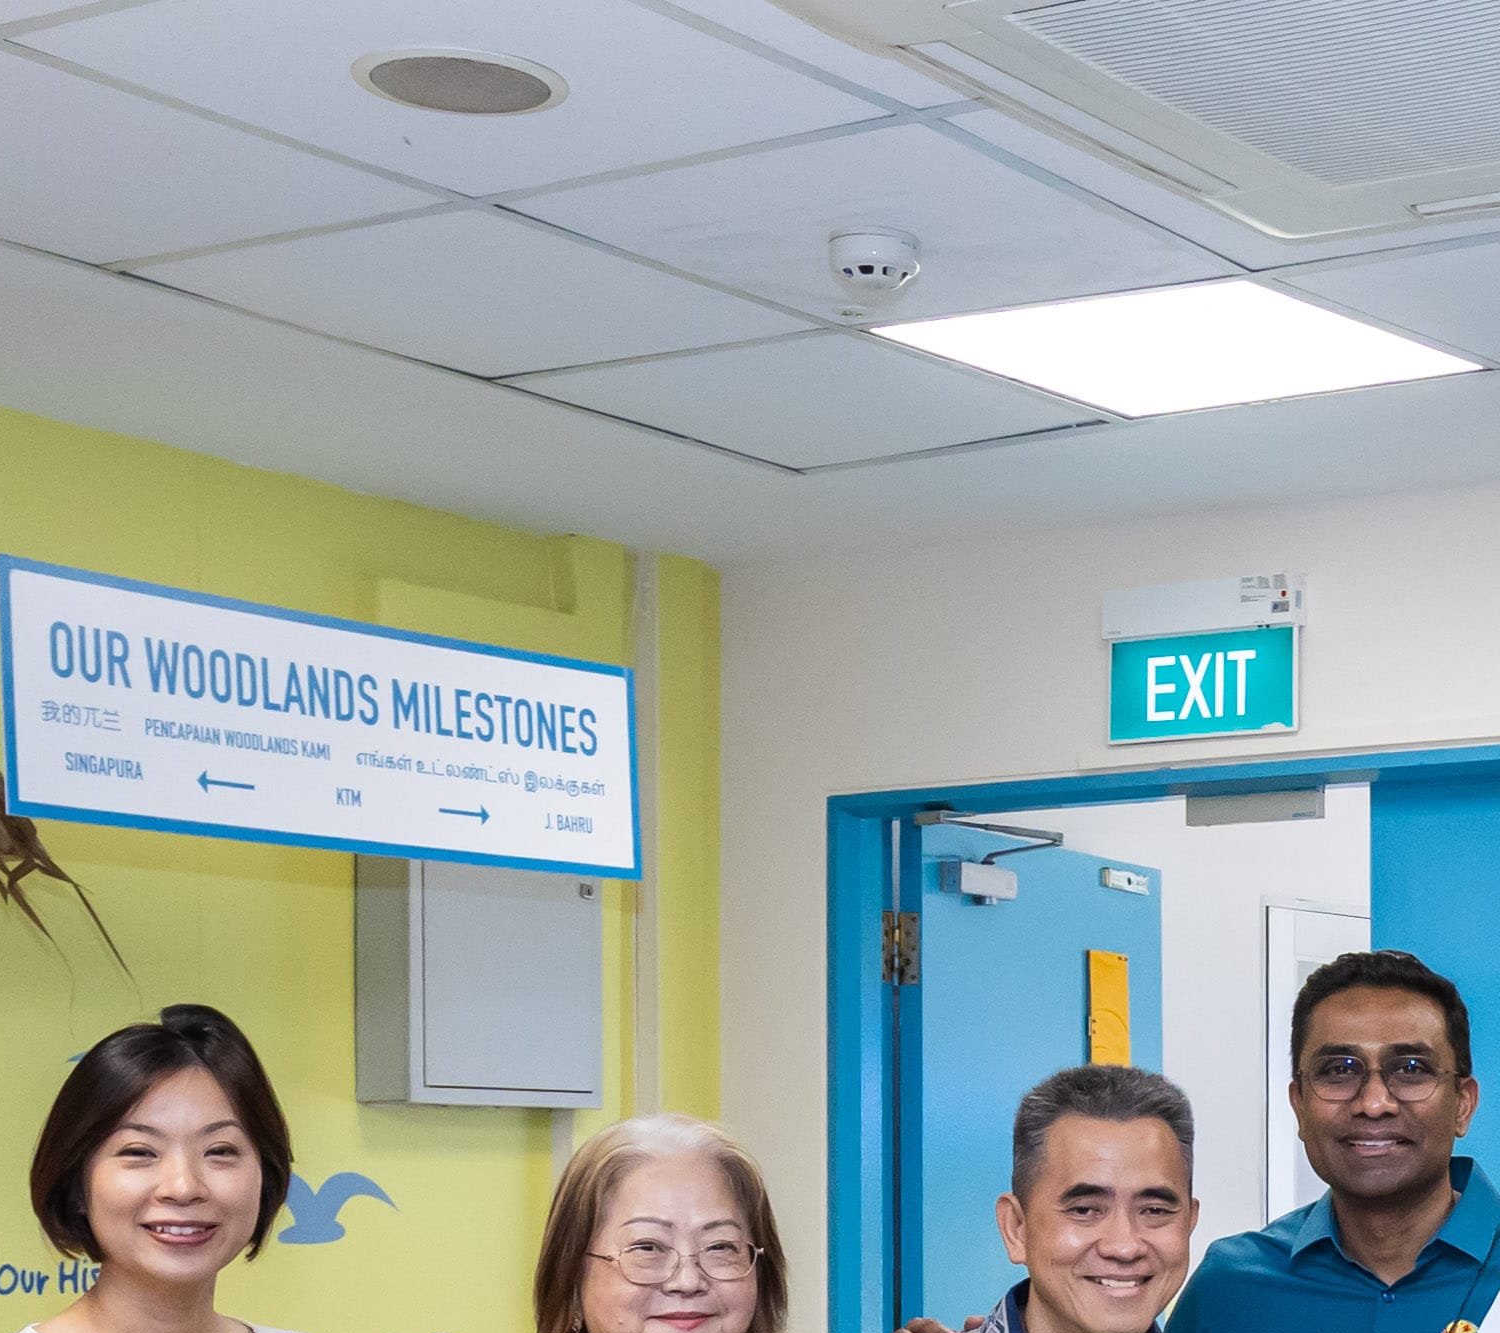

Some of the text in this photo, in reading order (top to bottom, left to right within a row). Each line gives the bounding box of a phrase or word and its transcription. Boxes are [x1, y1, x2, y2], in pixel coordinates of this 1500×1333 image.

[50, 621, 598, 756] OUR WOODLANDS MILESTONES
[1147, 650, 1256, 722] EXIT
[41, 700, 122, 732] 我的兀兰
[145, 718, 331, 761] PENCAPAIAN WOODLANDS KAMI
[65, 751, 143, 782] SINGAPURA
[336, 788, 362, 807] KTM
[556, 815, 593, 834] BAHRU
